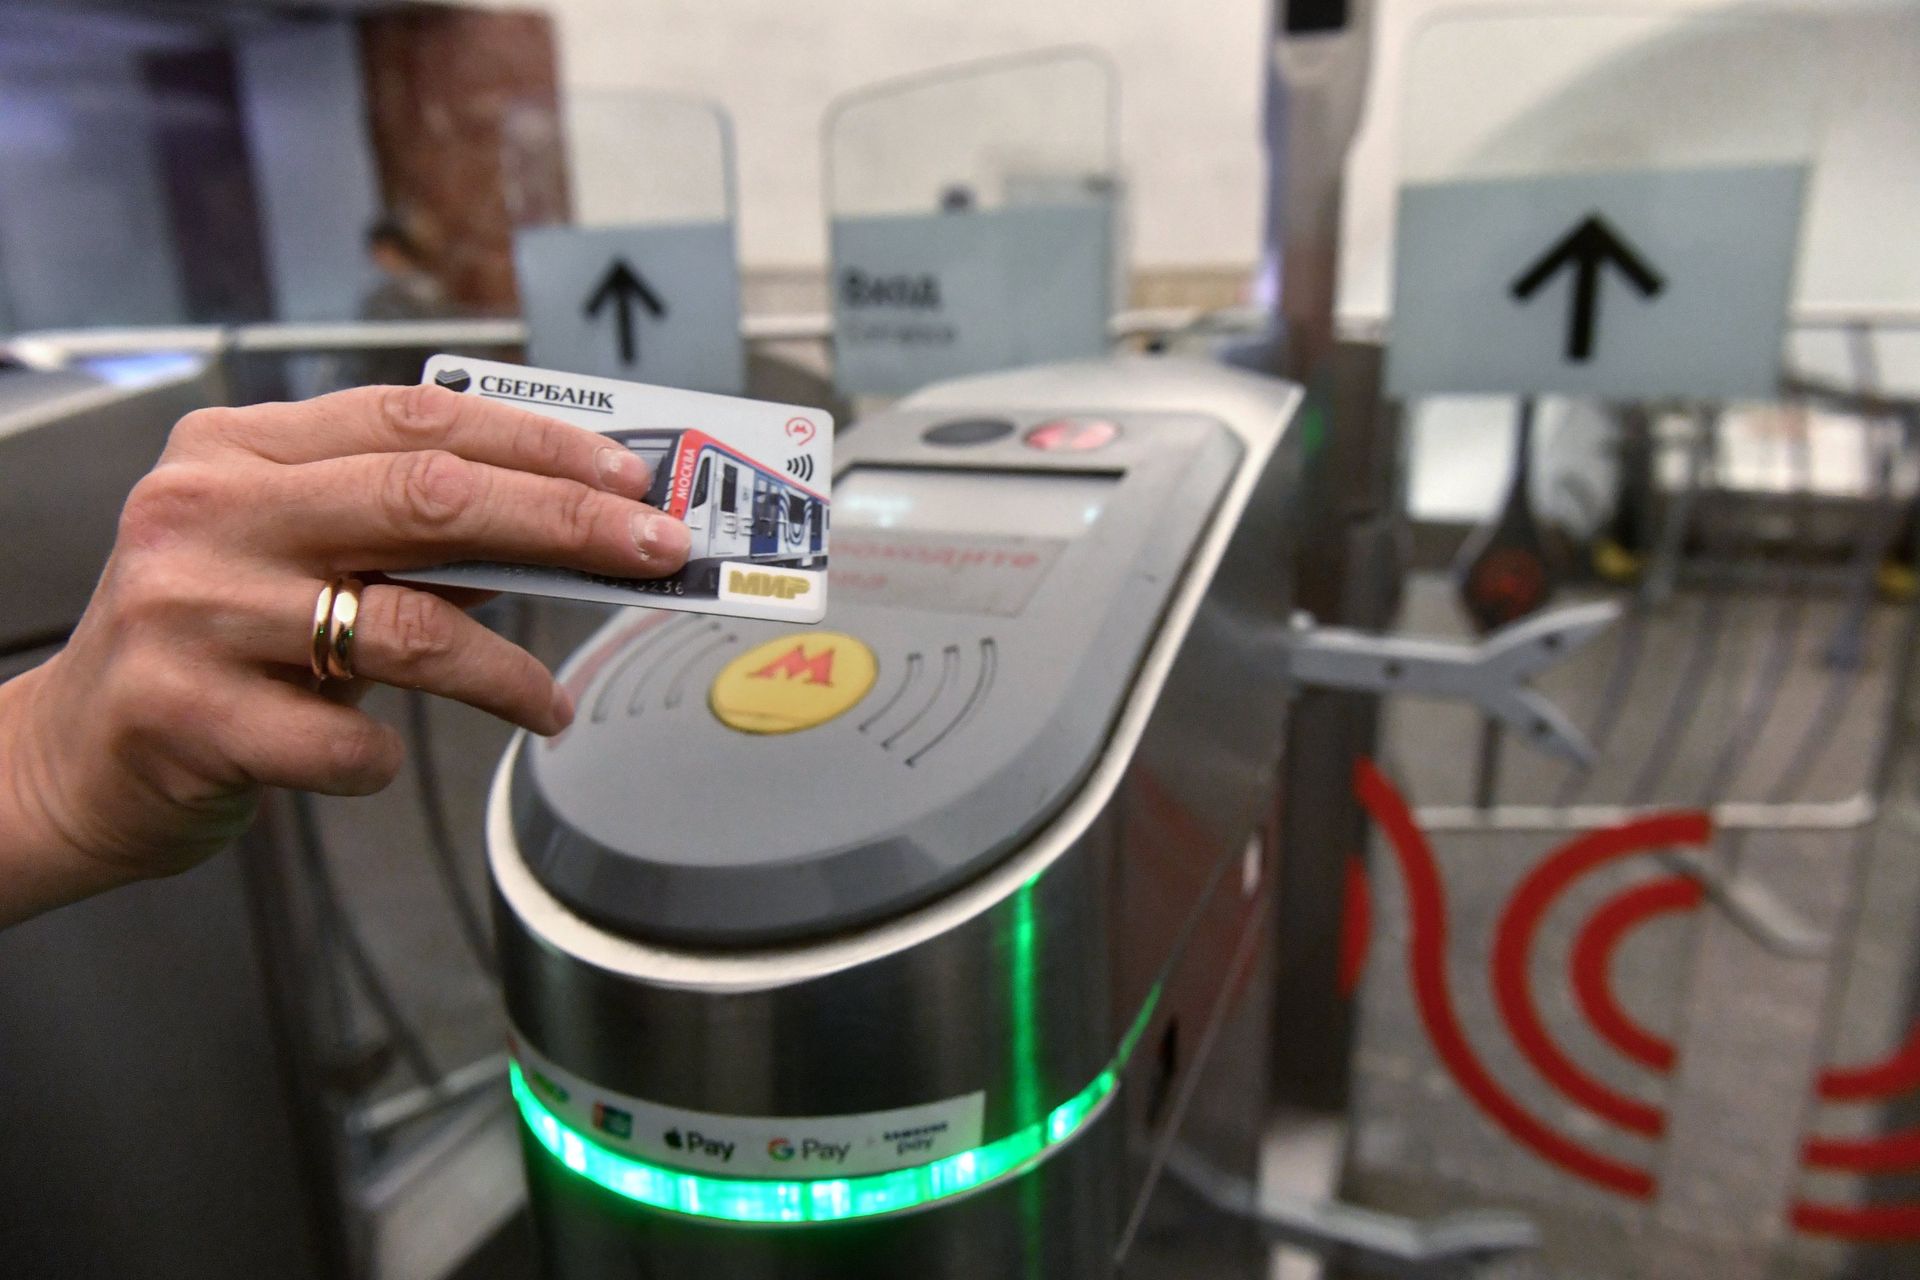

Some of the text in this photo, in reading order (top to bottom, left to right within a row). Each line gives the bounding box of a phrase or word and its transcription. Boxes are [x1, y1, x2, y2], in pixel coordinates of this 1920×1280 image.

[480, 375, 614, 409] СБЕРБАНК
[676, 448, 696, 500] МОСКВА
[728, 570, 811, 600] МИР
[686, 1131, 735, 1163] Pay
[802, 1137, 852, 1164] Pay
